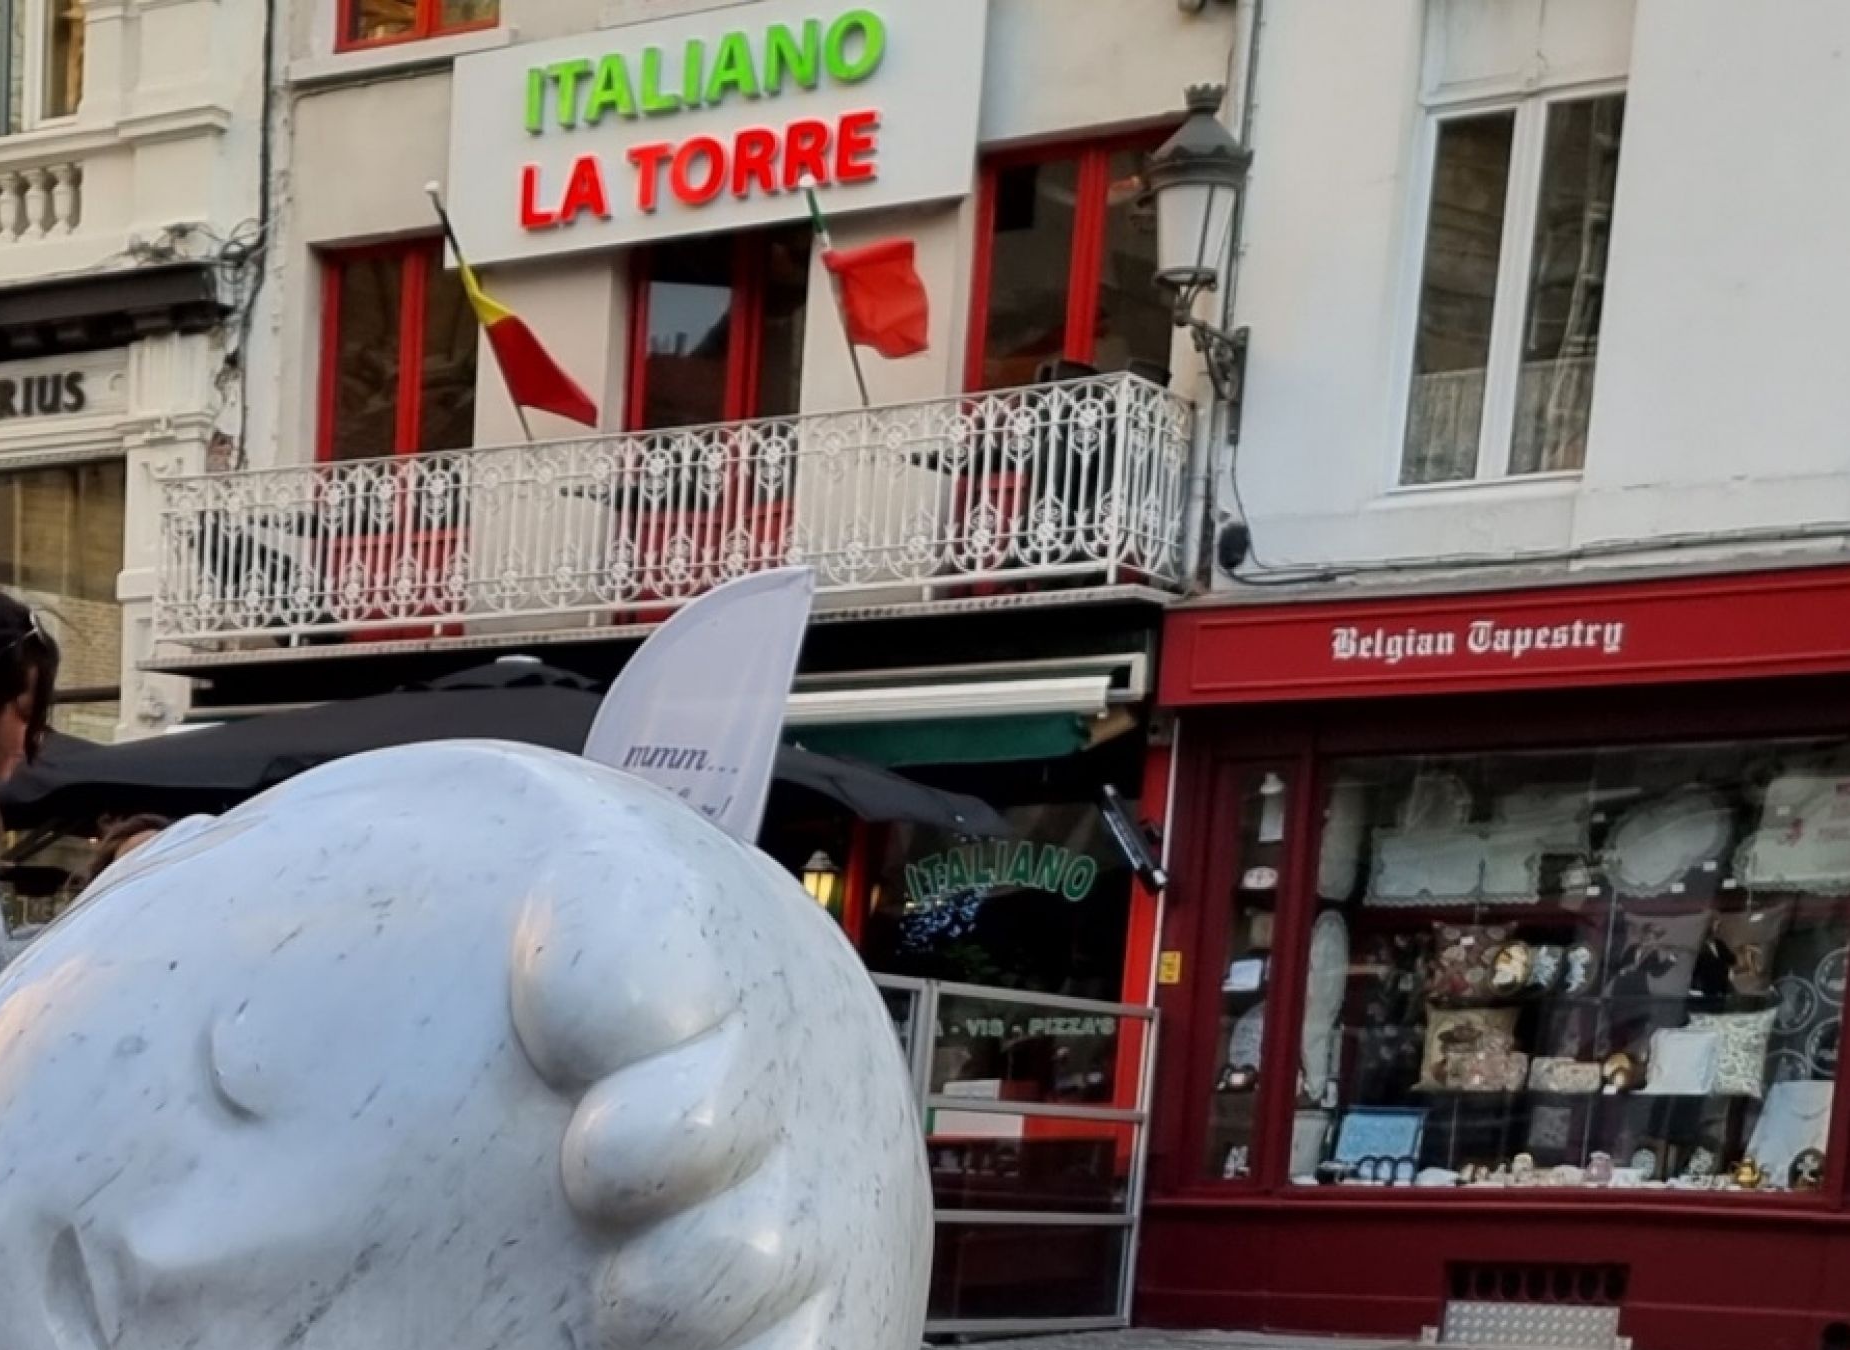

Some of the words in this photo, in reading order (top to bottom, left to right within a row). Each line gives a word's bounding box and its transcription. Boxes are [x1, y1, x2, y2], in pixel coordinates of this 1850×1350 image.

[524, 9, 885, 136] ITALIANO
[519, 155, 611, 231] LA
[627, 110, 881, 214] TORRE
[1332, 627, 1455, 664] Belgian
[1467, 620, 1624, 659] Tapestry
[904, 840, 1098, 902] ITALIANO
